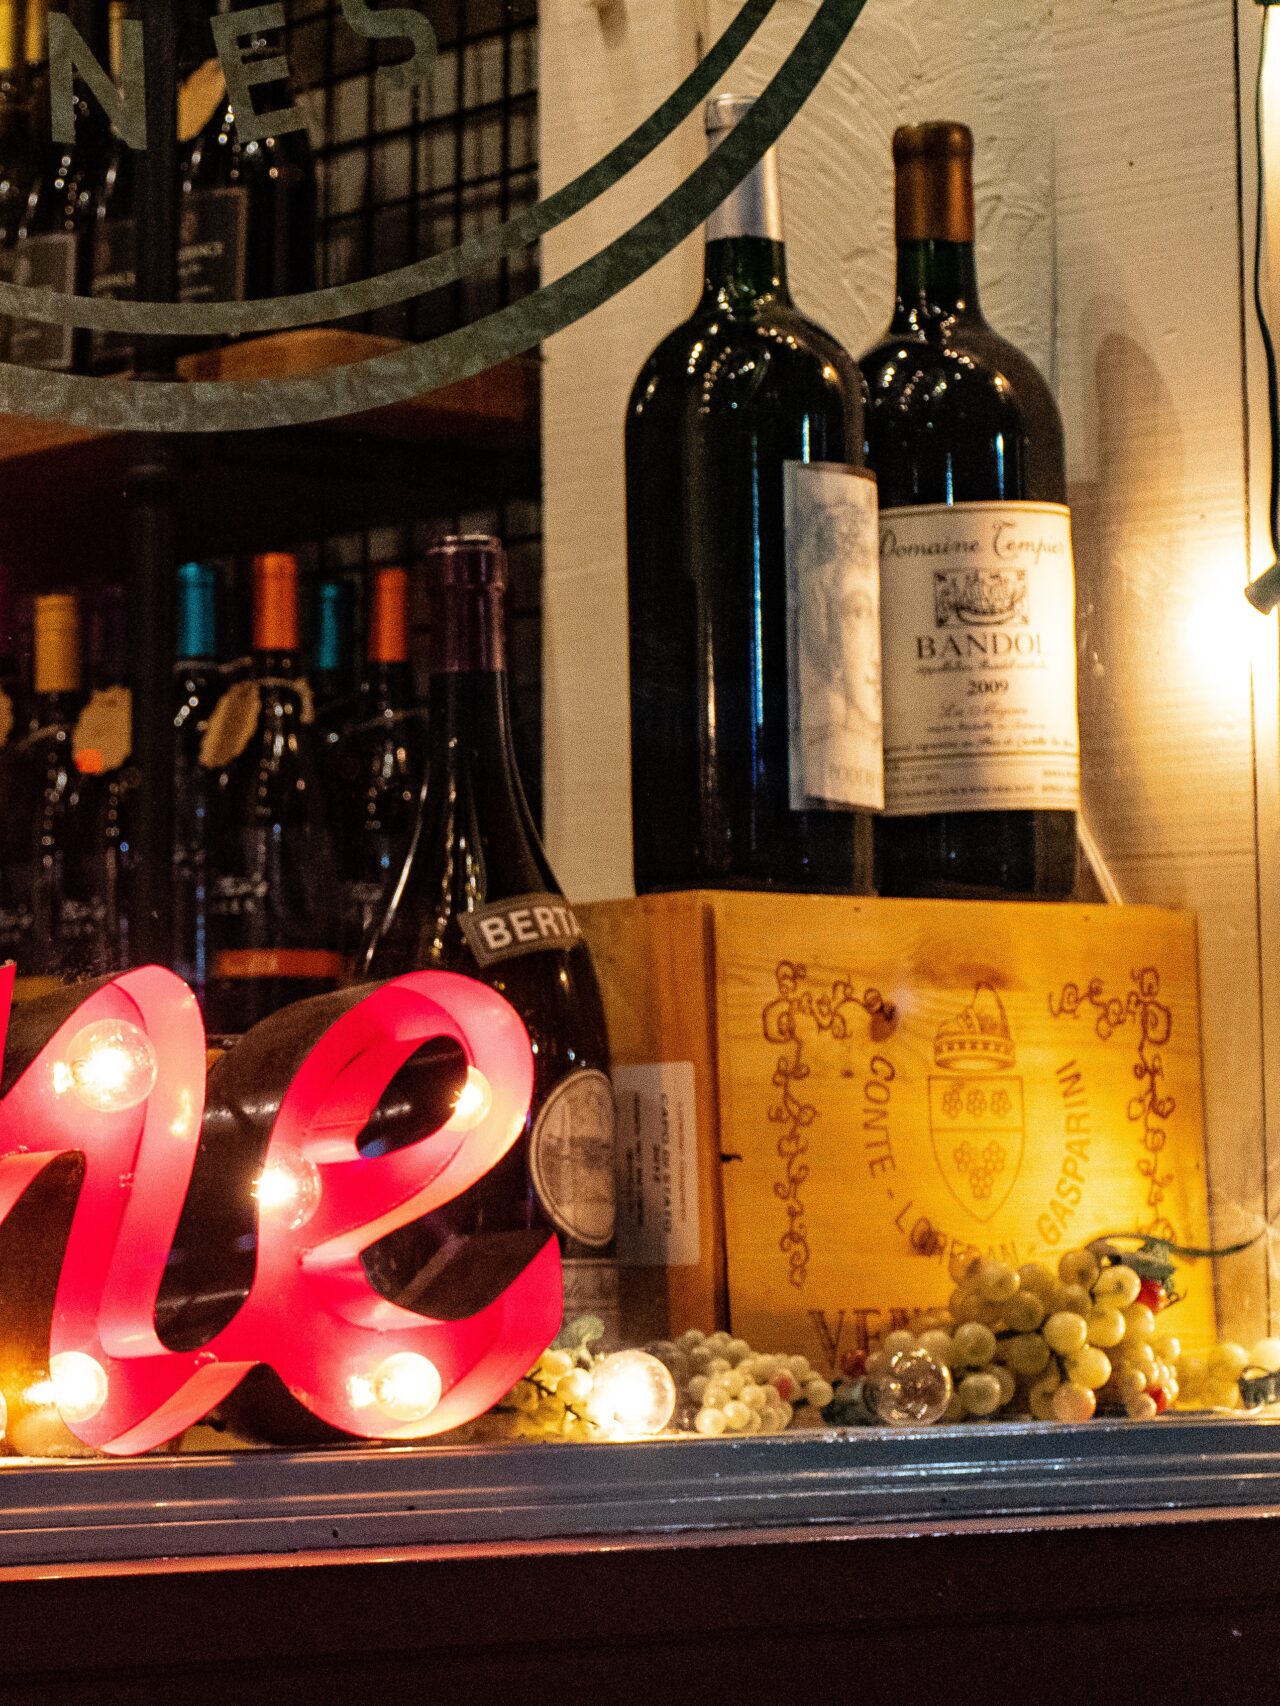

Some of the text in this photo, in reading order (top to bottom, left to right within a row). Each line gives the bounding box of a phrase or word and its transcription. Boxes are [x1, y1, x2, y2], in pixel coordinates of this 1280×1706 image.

[880, 528, 980, 558] Domaine
[966, 679, 1010, 697] 2009
[862, 1054, 896, 1178] CONTE
[1036, 1059, 1092, 1246] GASPARINI
